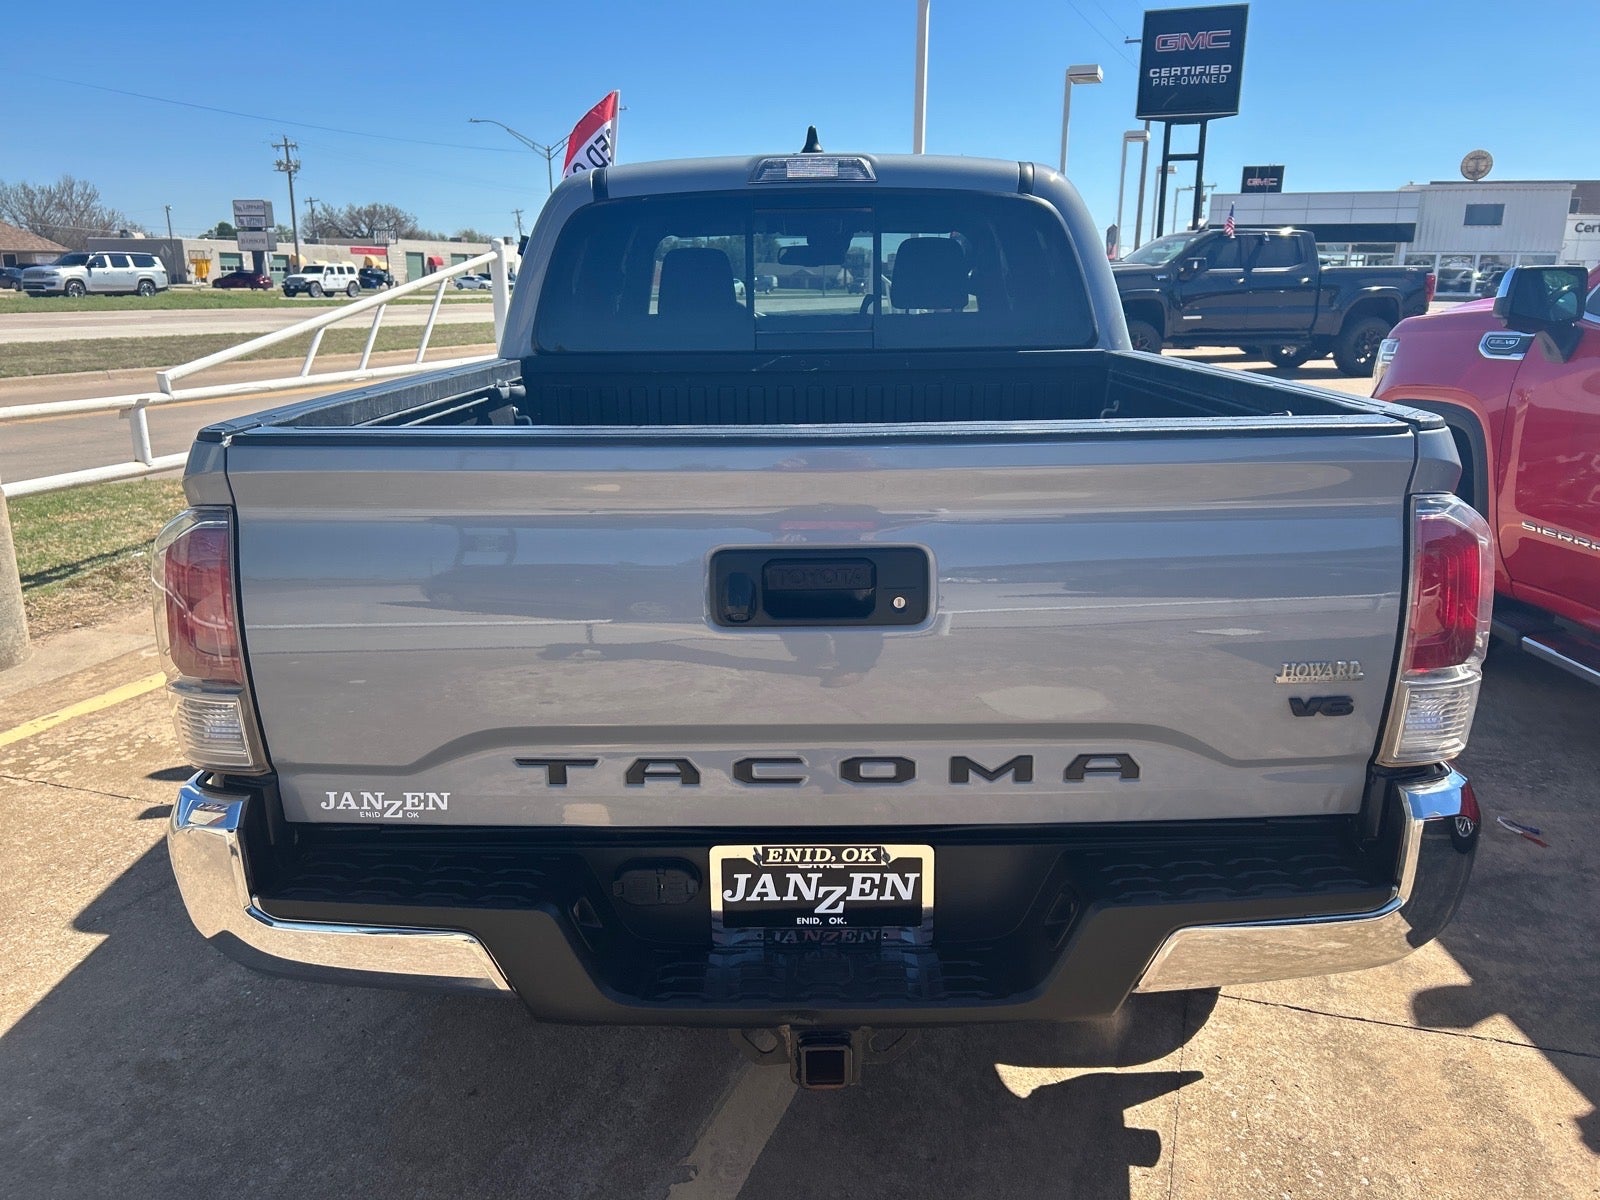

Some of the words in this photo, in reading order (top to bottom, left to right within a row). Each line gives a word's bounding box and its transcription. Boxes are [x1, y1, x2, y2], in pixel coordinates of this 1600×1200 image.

[1155, 30, 1232, 52] GMC
[1149, 64, 1232, 77] CERTIFIED
[1152, 74, 1227, 86] PRE-OWNED
[1247, 178, 1278, 186] GMC
[1280, 661, 1364, 677] HOWARD
[1288, 695, 1354, 717] V6
[514, 753, 1140, 786] TACOMA
[320, 791, 451, 818] JANZEN
[766, 848, 836, 864] ENID,
[841, 848, 878, 863] OK
[722, 872, 920, 914] JANZEN
[796, 917, 822, 926] ENID,
[828, 917, 847, 925] OK.
